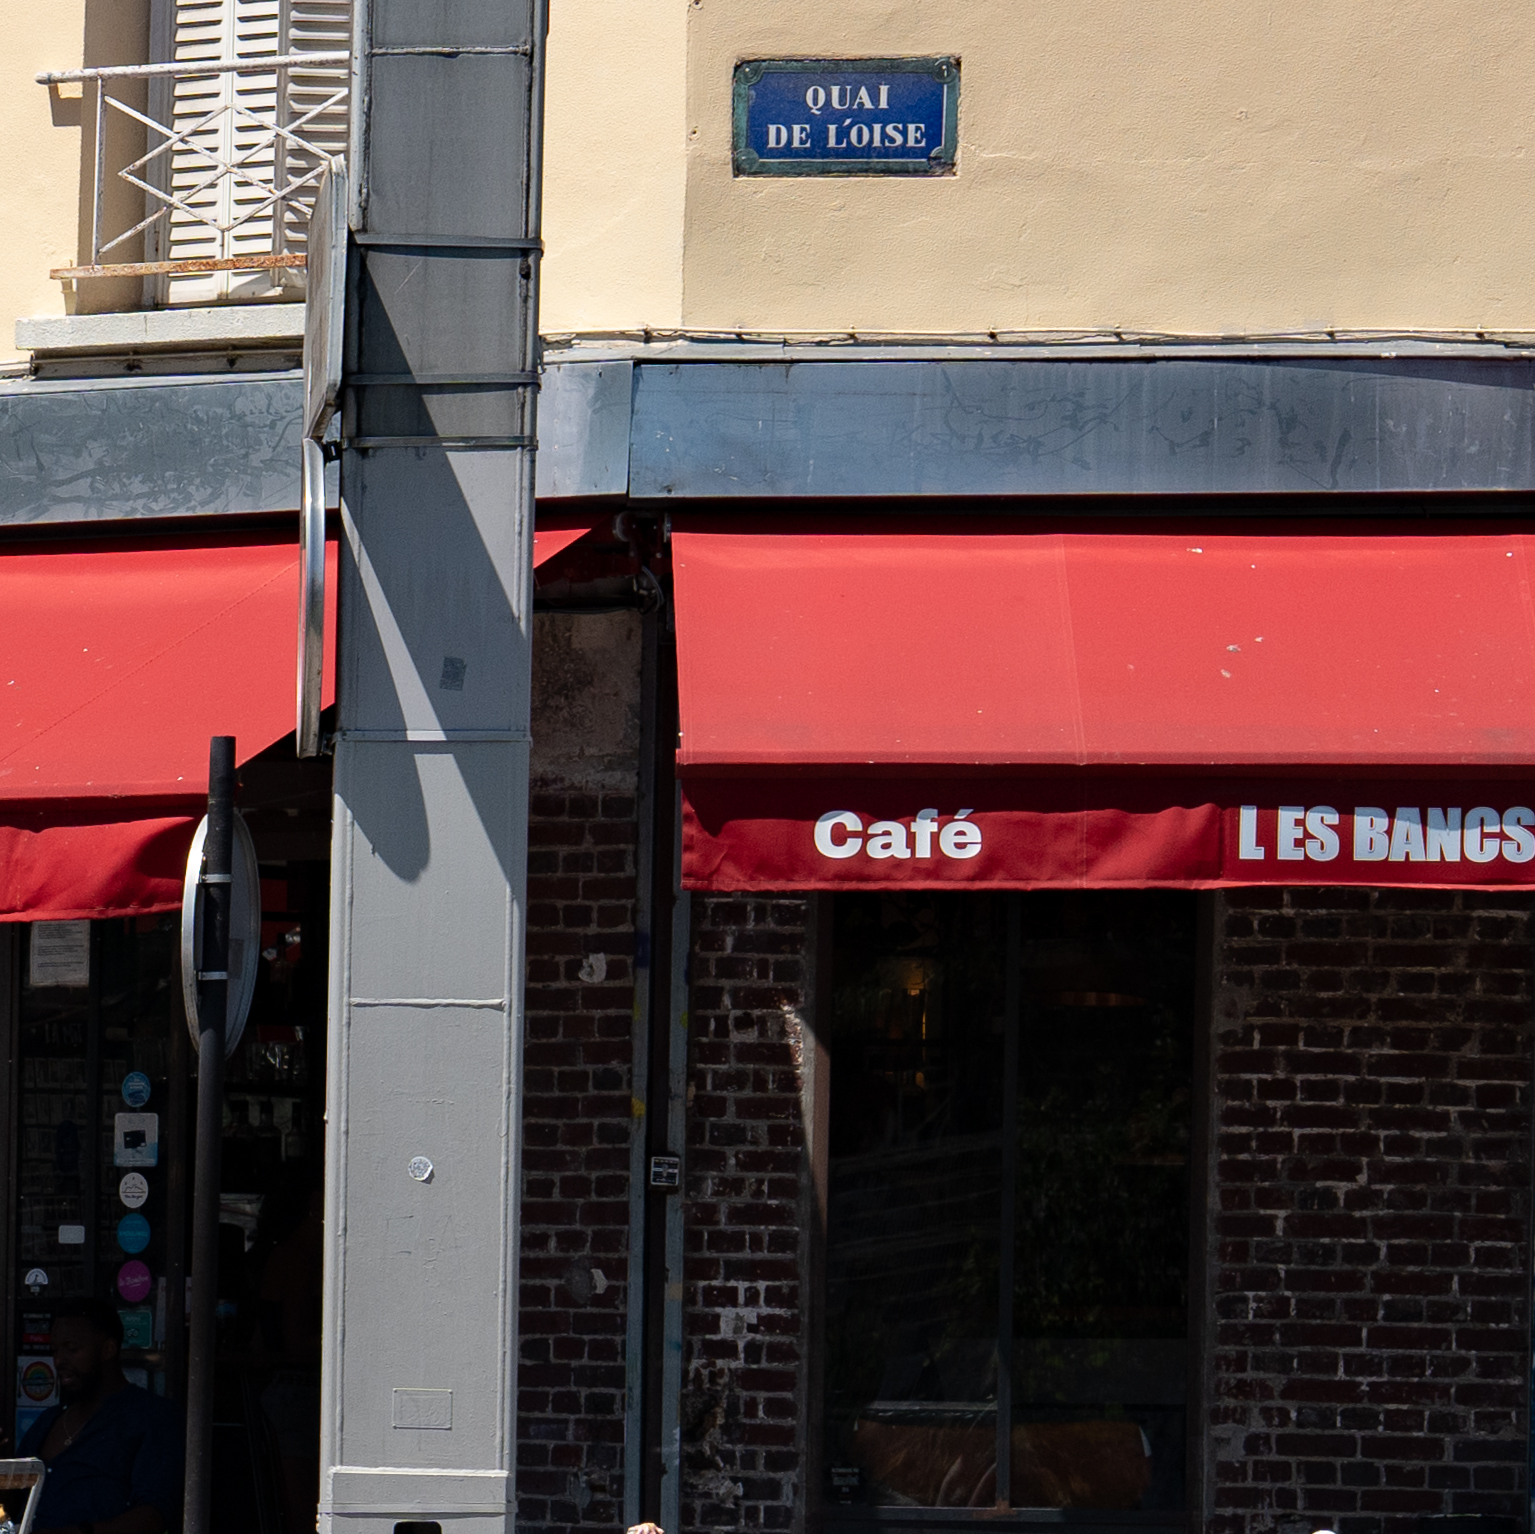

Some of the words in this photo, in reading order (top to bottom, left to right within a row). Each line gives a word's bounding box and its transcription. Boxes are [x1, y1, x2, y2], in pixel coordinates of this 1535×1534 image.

[805, 84, 890, 115] QUAI
[766, 123, 812, 149] DE
[826, 118, 928, 149] L'OISE
[812, 806, 983, 861] Café
[1237, 804, 1341, 862] LES
[1352, 805, 1535, 863] BANCS
